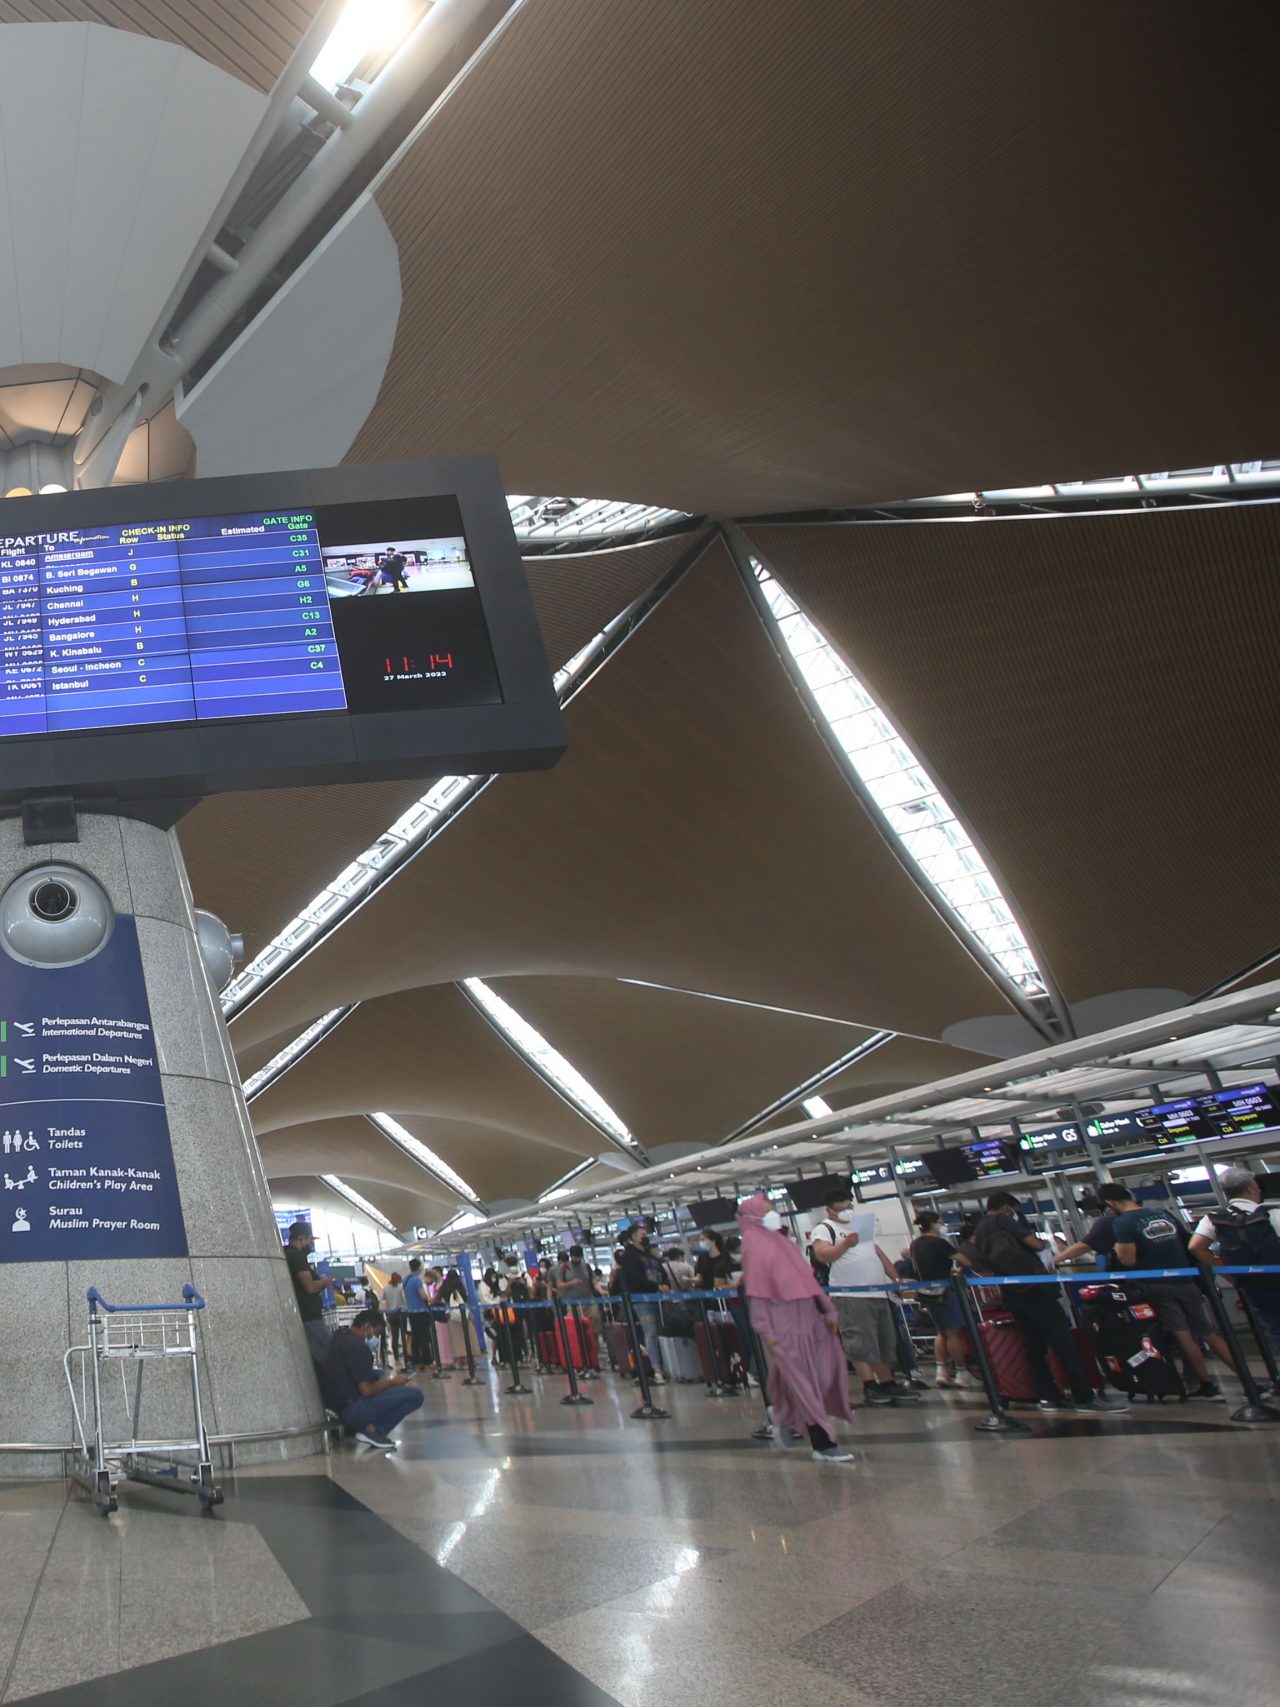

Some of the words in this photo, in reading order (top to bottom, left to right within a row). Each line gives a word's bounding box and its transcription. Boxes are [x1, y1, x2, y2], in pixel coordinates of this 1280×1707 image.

[263, 516, 288, 525] GATE
[290, 514, 313, 523] INFO
[122, 525, 167, 536] CHECK-IN
[168, 523, 191, 532] INFO
[221, 525, 265, 536] Estimated
[288, 522, 308, 531] Gate
[119, 536, 138, 545] Row
[157, 532, 185, 541] Status
[290, 534, 307, 542] C35
[1, 547, 26, 556] Flight
[57, 569, 75, 577] Seri
[78, 566, 118, 577] Begawan
[292, 549, 310, 557] C31
[47, 584, 83, 595] Kuching
[47, 600, 84, 610] Chennai
[297, 580, 310, 588] G6
[48, 614, 96, 627] Hyderabad
[300, 596, 312, 604] H2
[49, 631, 95, 642] Bangalore
[302, 612, 320, 620] C13
[50, 650, 60, 658] K.
[62, 646, 102, 657] Kinabalu
[305, 628, 317, 636] A2
[51, 664, 78, 674] Seoul
[85, 662, 121, 671] Incheon
[308, 644, 326, 652] C37
[52, 680, 89, 690] Istanbul
[310, 661, 324, 669] C4
[42, 1017, 90, 1027] Perlepasan
[91, 1017, 150, 1031] Antarabangsa
[42, 1028, 96, 1037] International
[97, 1028, 142, 1040] Departures
[43, 1053, 91, 1063] Perlepasan
[92, 1053, 123, 1063] Dalam
[124, 1055, 153, 1067] Negeri
[43, 1064, 83, 1073] Domestic
[84, 1064, 131, 1075] Departures
[47, 1127, 86, 1137] Tandas
[48, 1140, 83, 1149] Toilets
[48, 1167, 87, 1177] Taman
[89, 1167, 161, 1179] Kanak-Kanak
[48, 1180, 101, 1190] Children's
[104, 1180, 127, 1192] Play
[129, 1181, 153, 1191] Area
[49, 1206, 83, 1216] Surau
[49, 1218, 89, 1229] Muslim
[92, 1218, 127, 1231] Prayer
[130, 1219, 160, 1230] Room
[417, 1227, 427, 1239] G
